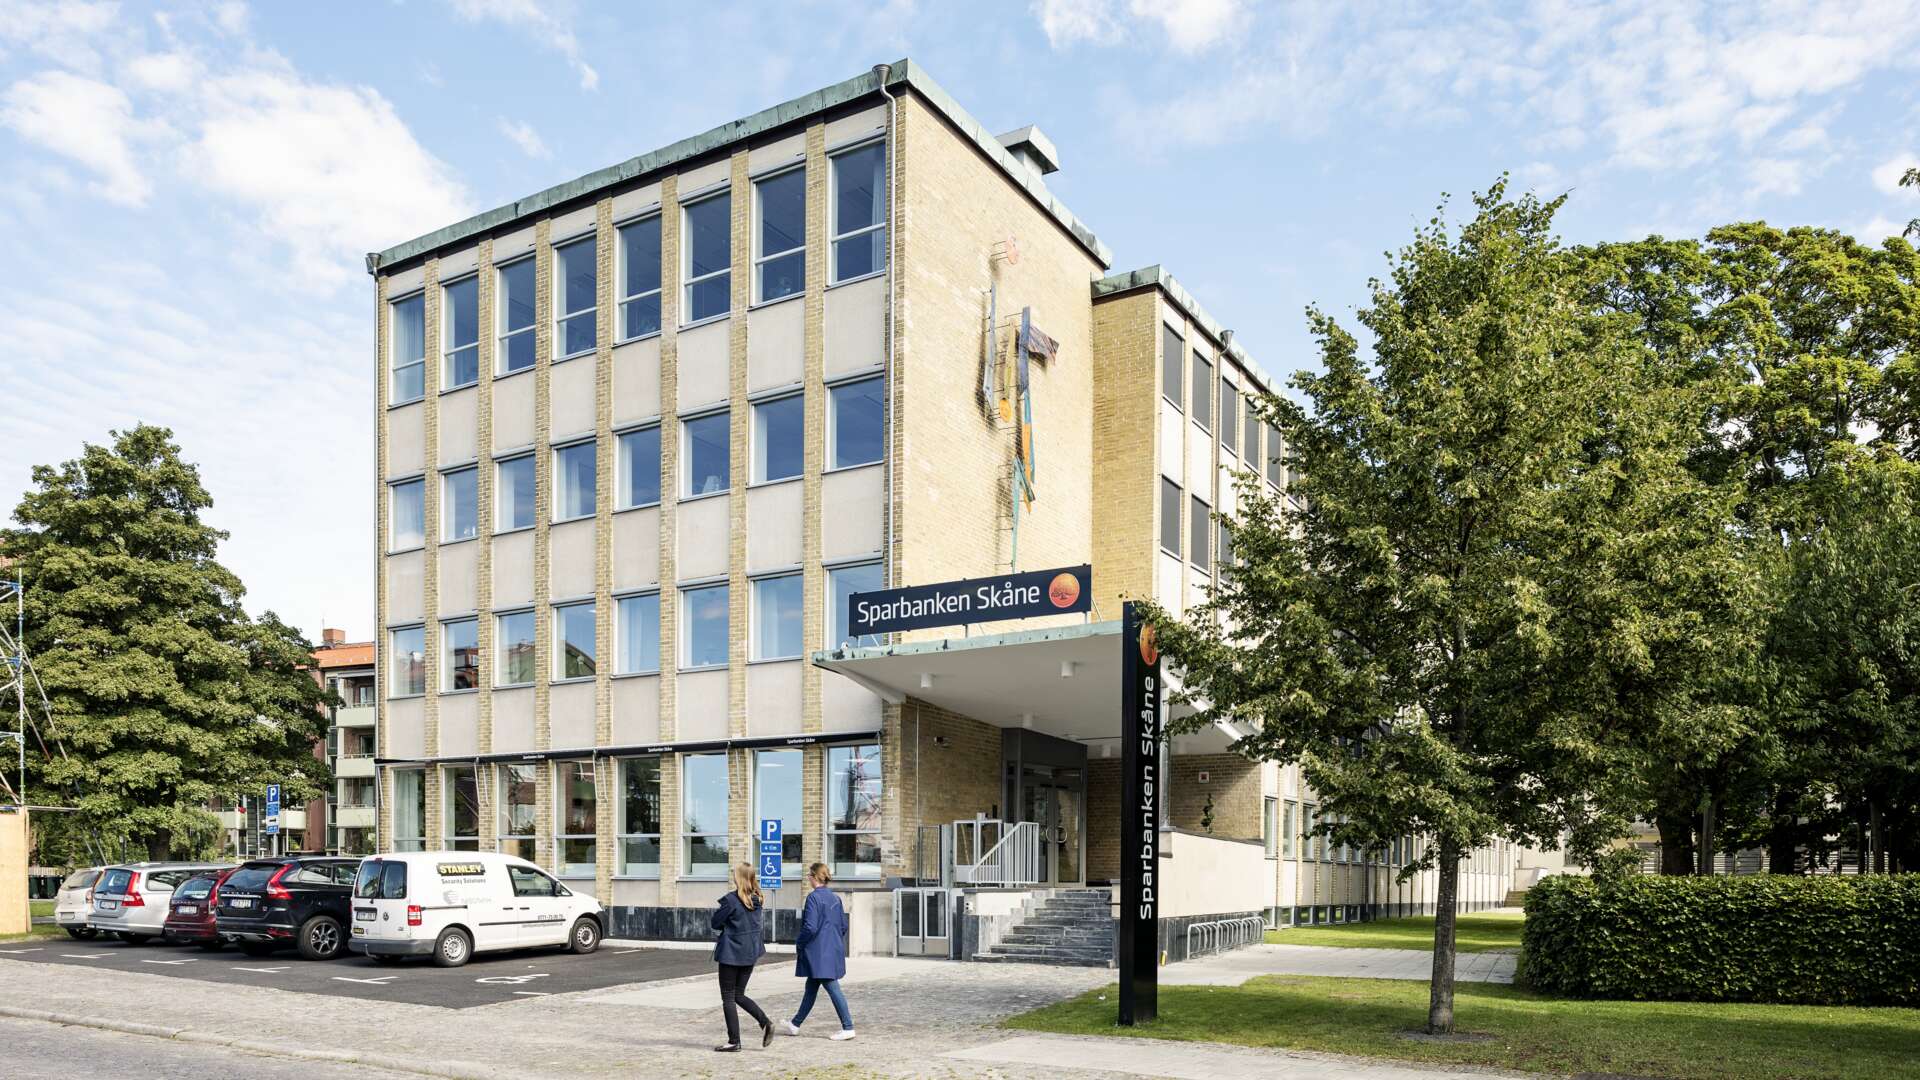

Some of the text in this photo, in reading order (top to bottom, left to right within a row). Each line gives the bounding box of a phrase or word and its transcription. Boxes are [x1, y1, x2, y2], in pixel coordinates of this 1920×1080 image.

[857, 581, 1041, 627] Sparbanken Skåne
[271, 788, 277, 801] P
[1139, 675, 1155, 920] Sparbanken Skåne
[767, 821, 777, 839] P
[439, 864, 481, 874] STANLEY
[441, 878, 463, 886] Security
